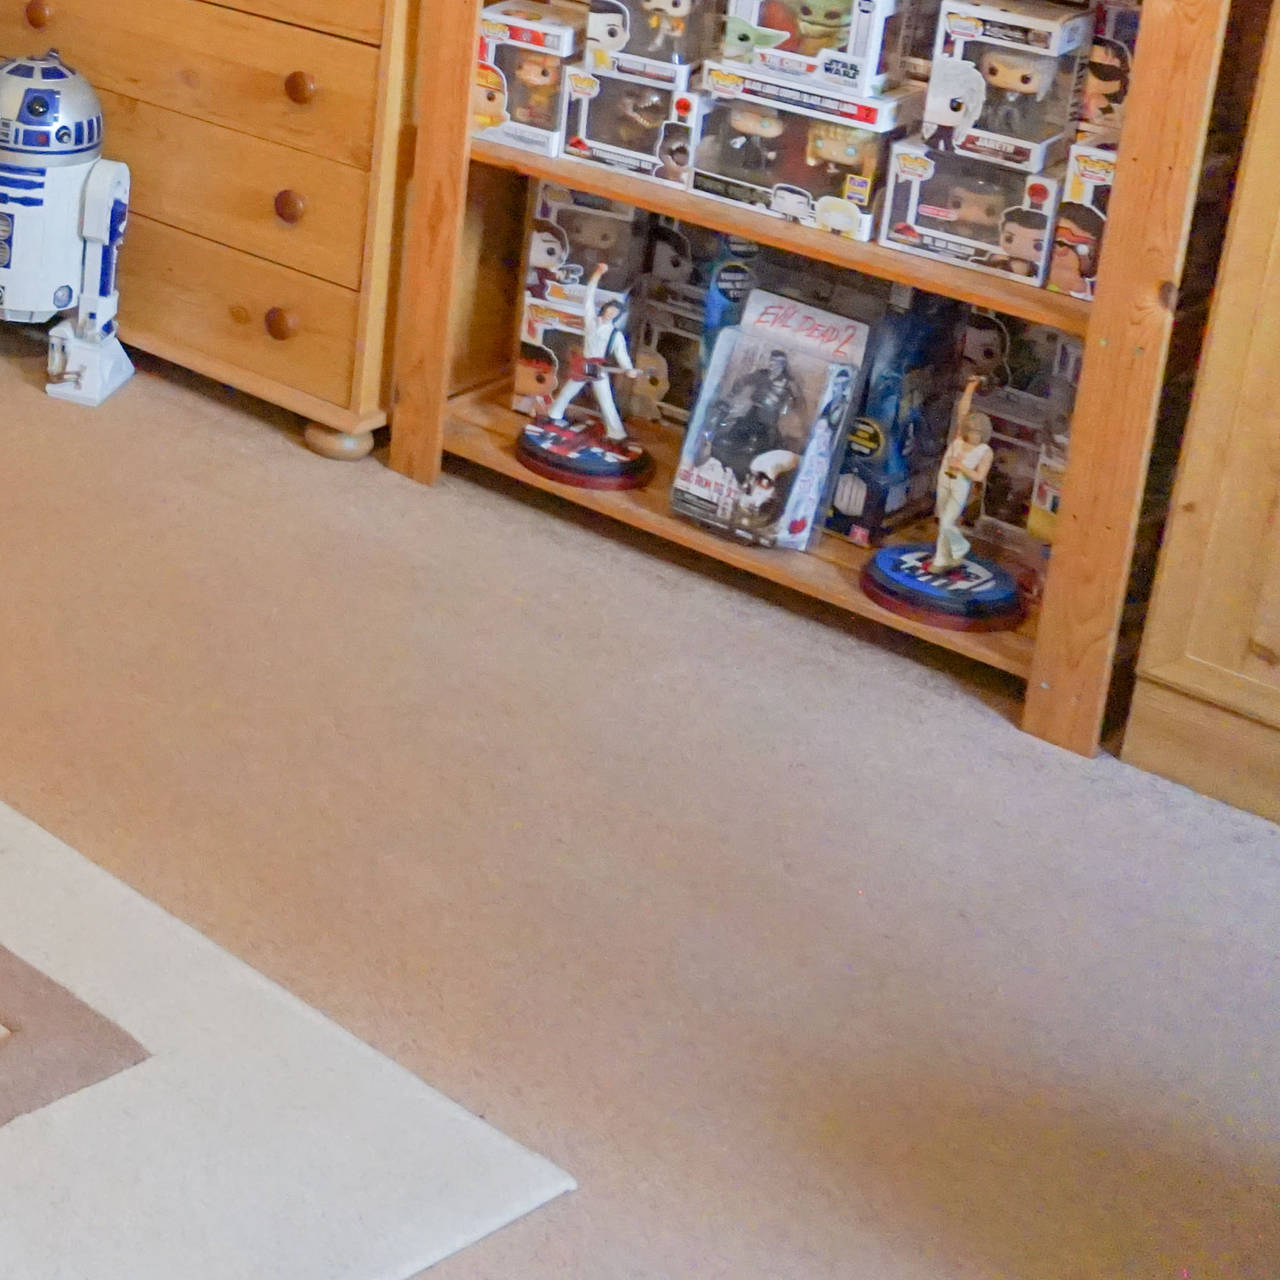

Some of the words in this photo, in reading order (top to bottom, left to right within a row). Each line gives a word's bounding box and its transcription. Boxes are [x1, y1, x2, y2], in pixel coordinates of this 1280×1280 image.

[825, 58, 860, 71] STAR
[825, 67, 860, 80] WARS
[754, 304, 796, 330] EVIL
[796, 315, 839, 345] DEAD
[833, 324, 856, 358] 2
